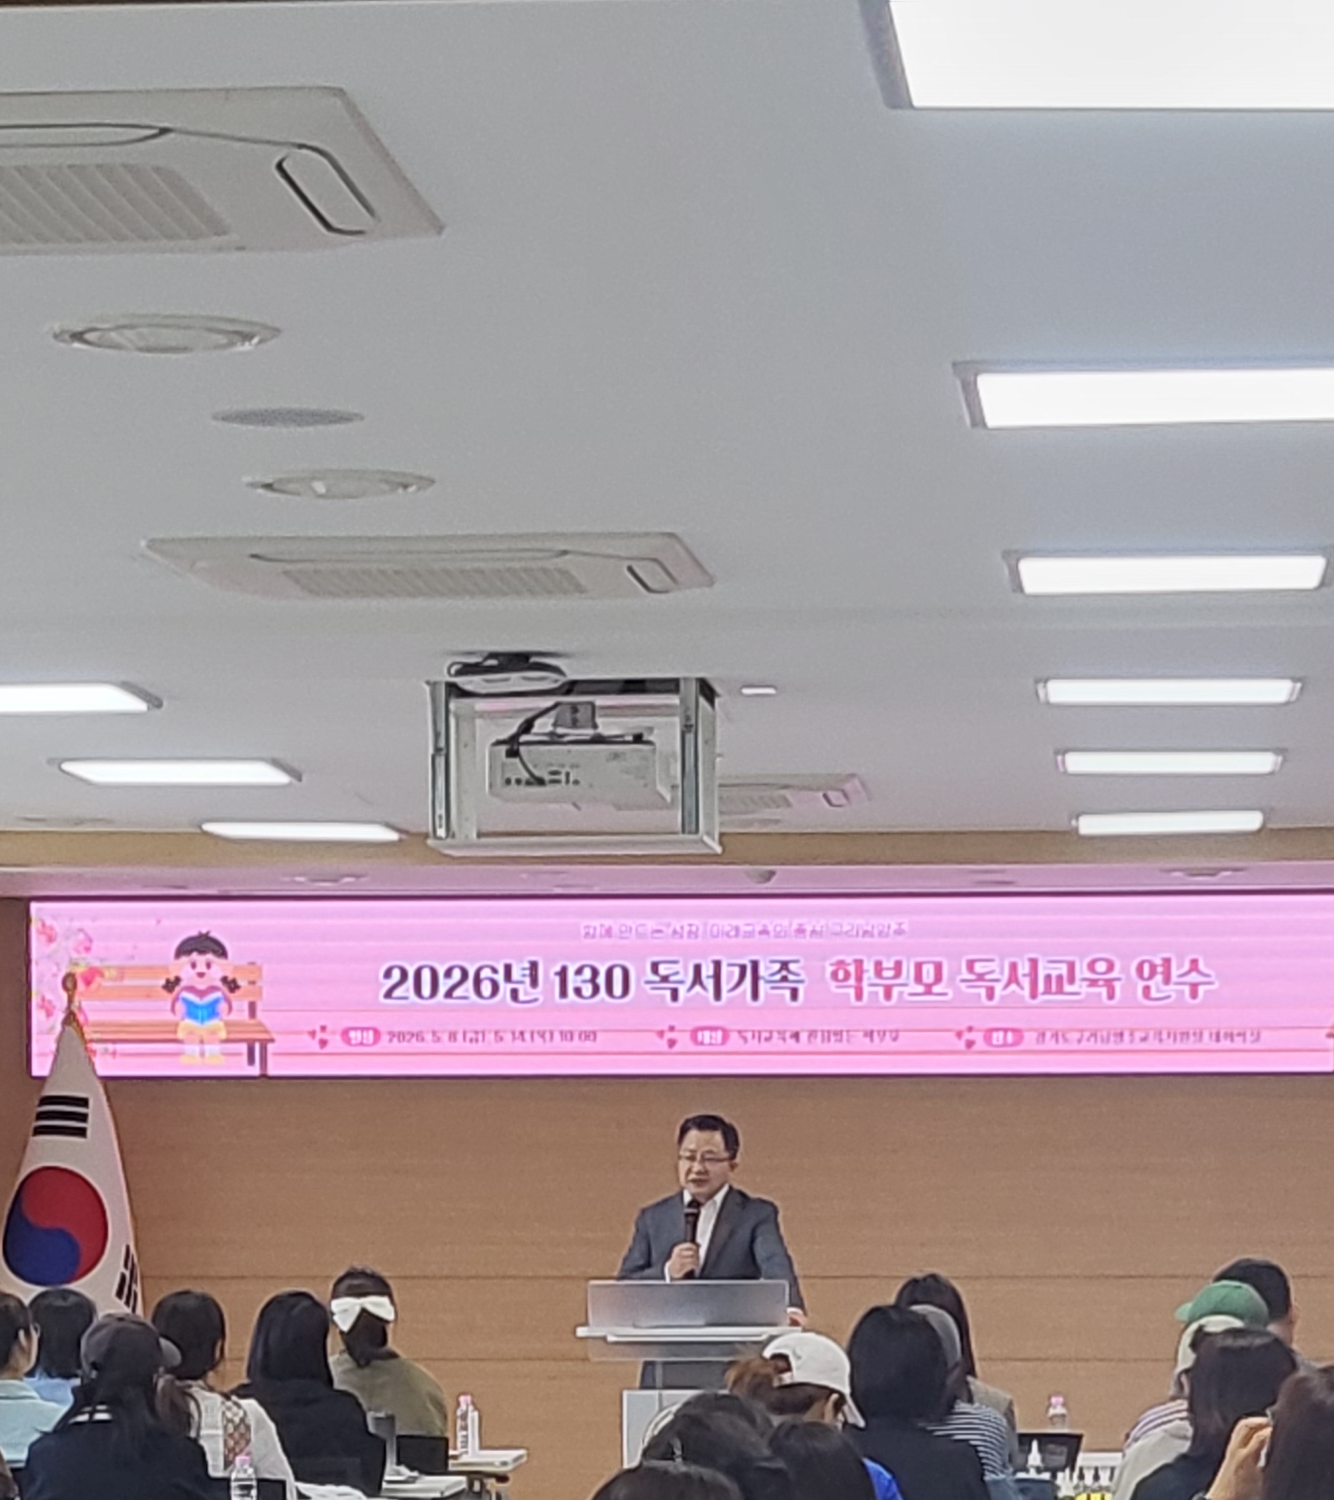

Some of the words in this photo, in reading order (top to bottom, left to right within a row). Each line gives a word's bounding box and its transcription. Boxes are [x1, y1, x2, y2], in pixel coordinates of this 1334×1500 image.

[382, 960, 540, 1003] 2026년
[553, 964, 632, 1001] 130
[644, 959, 806, 1003] 독서가족
[829, 958, 951, 1003] 학부모
[960, 958, 1121, 1002] 독서교육
[1136, 957, 1216, 1001] 연수
